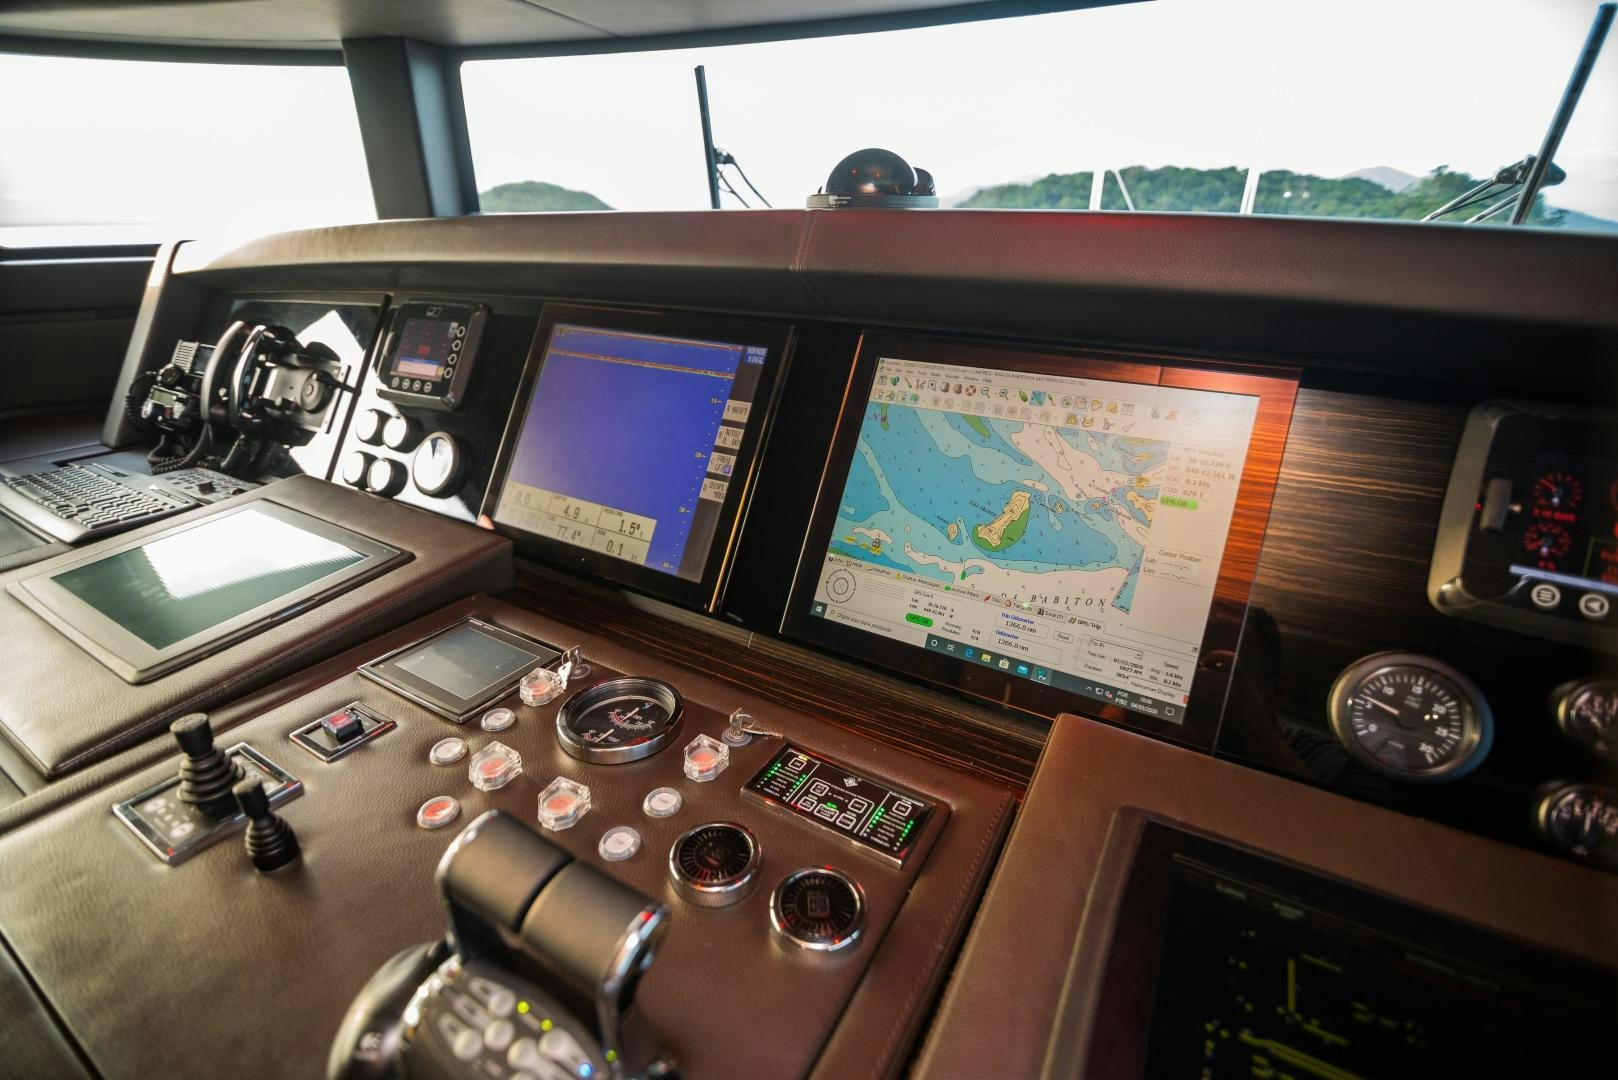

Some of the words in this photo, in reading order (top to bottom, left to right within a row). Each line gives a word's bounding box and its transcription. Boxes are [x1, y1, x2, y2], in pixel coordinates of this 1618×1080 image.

[563, 504, 580, 519] 4.9
[606, 540, 624, 556] 0.1
[1382, 686, 1395, 695] 10
